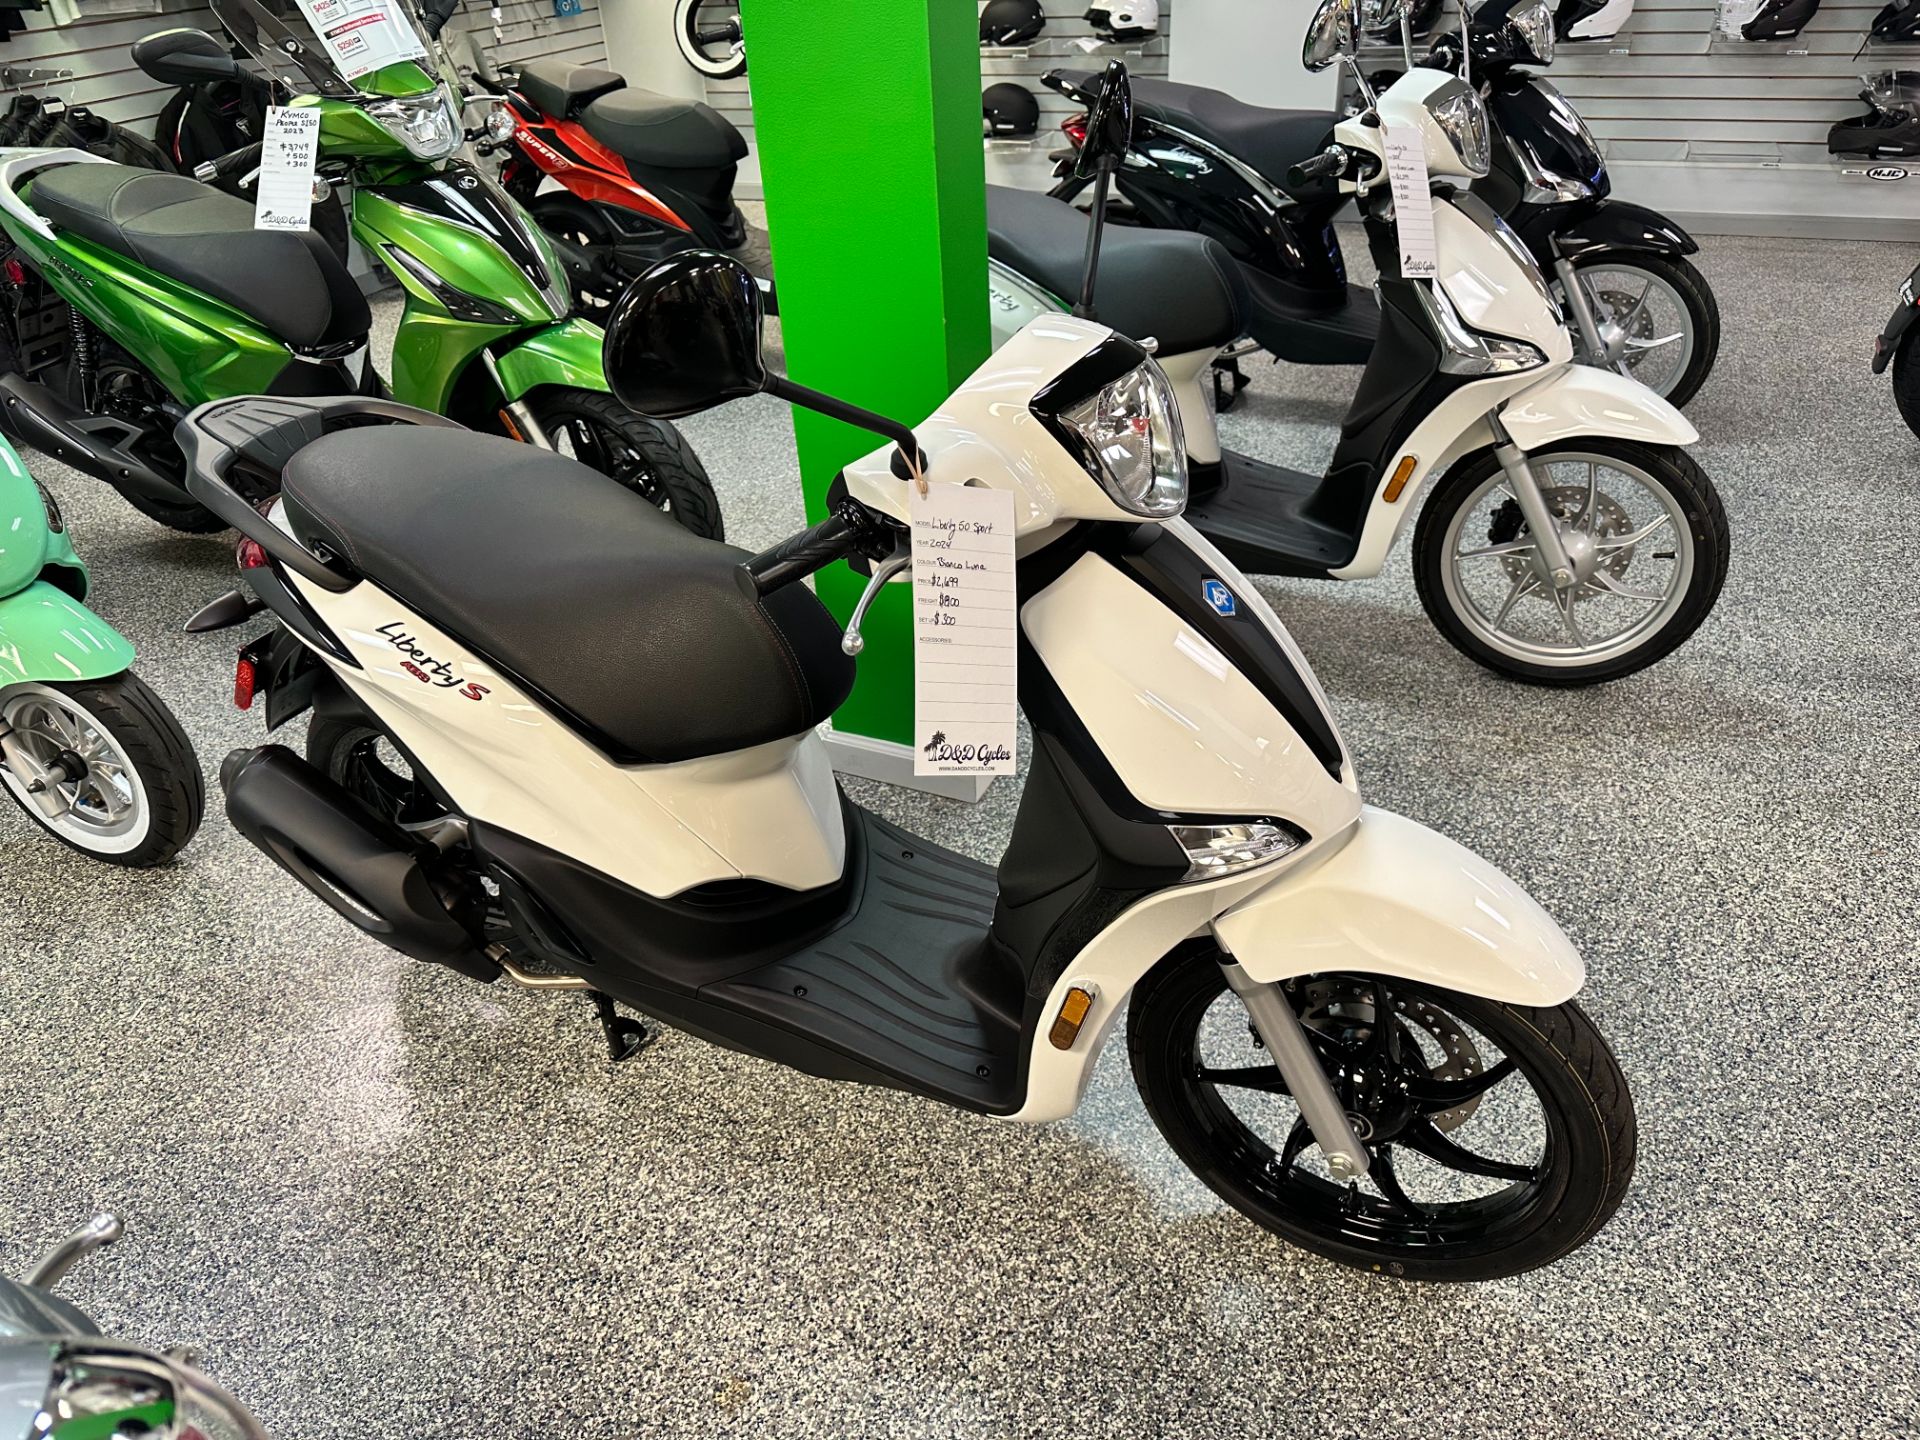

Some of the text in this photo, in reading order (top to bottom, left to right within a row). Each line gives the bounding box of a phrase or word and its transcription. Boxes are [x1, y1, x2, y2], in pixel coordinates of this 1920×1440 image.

[958, 520, 970, 531] 50
[929, 539, 952, 549] 2024
[375, 622, 491, 701] Liberty S
[977, 743, 1011, 767] Cycles
